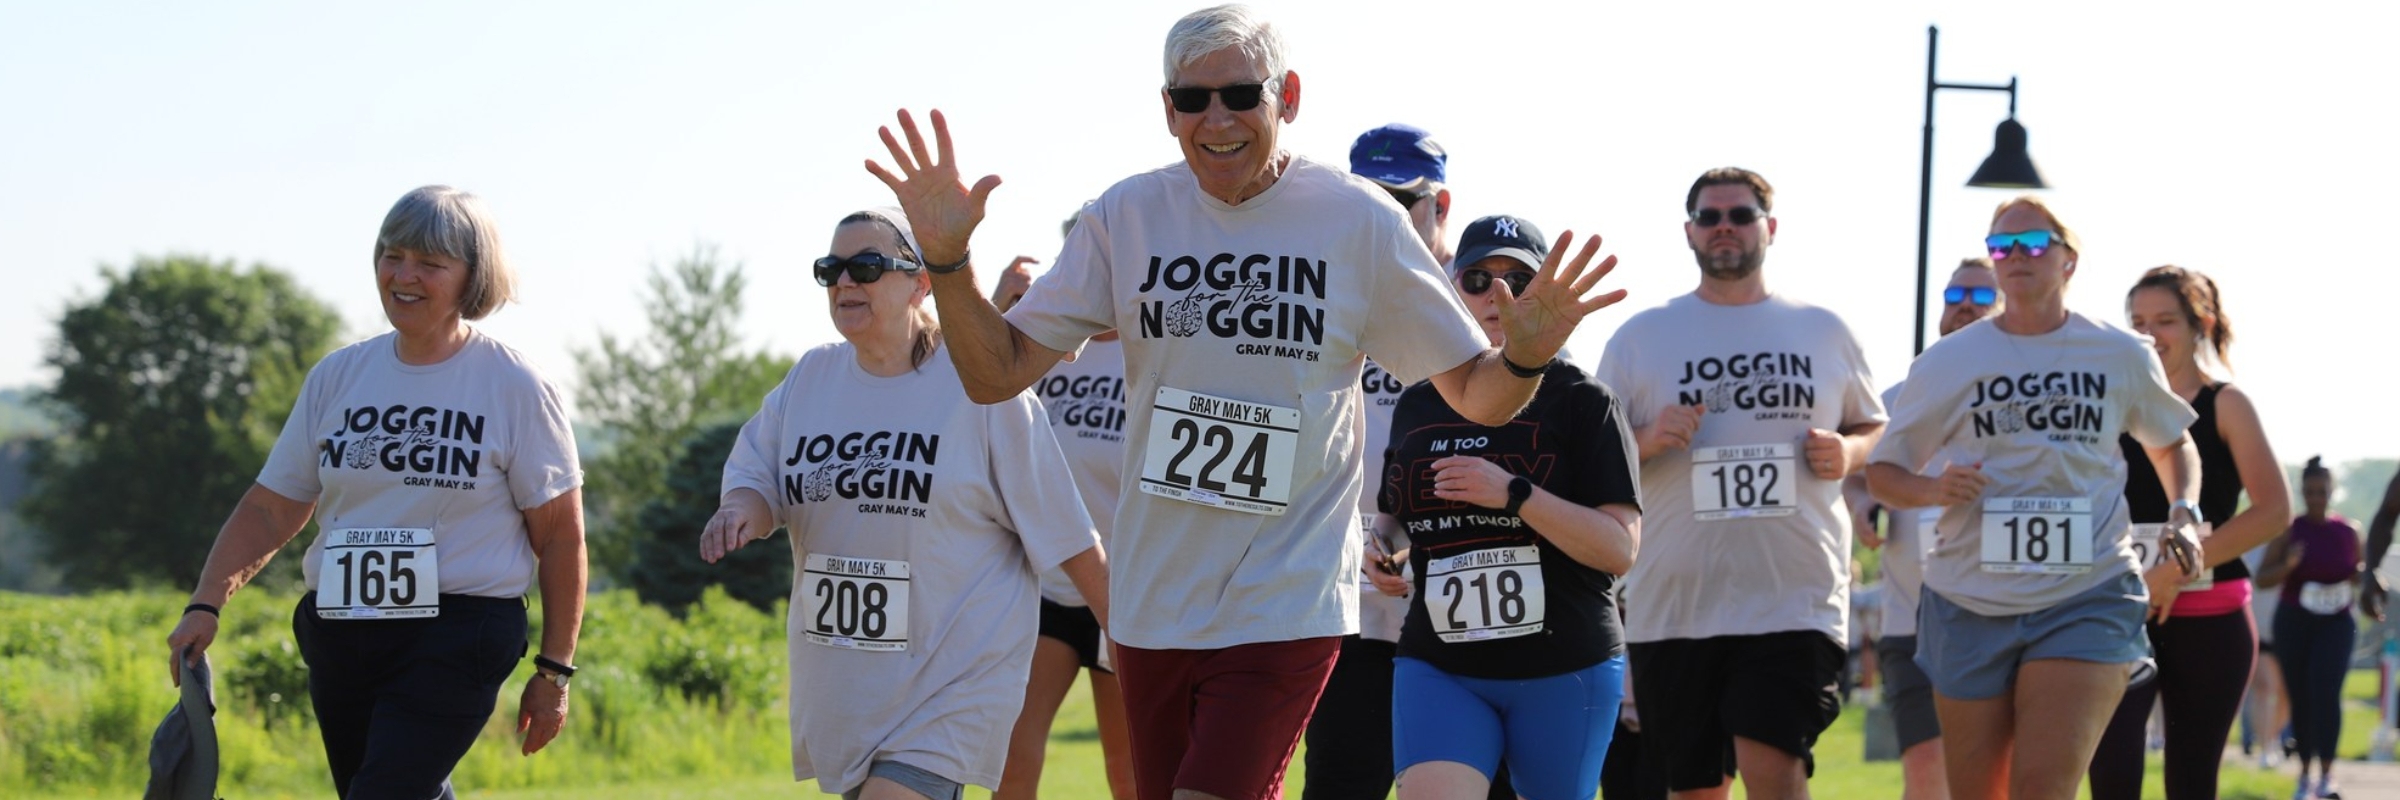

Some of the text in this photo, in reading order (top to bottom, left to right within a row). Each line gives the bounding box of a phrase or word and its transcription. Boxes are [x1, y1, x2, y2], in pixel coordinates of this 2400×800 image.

[1493, 217, 1519, 238] NY
[1139, 253, 1327, 300] JOGGIN
[1181, 282, 1227, 312] for
[1236, 343, 1320, 362] GRAY MAY 5K
[1679, 352, 1812, 385] JOGGIN
[1970, 372, 2106, 408] JOGGIN
[333, 404, 485, 445] JOGGIN
[1189, 395, 1272, 424] GRAY MAY 5K
[785, 431, 940, 467] JOGGIN
[1165, 418, 1269, 498] 224
[1430, 436, 1489, 452] IM TOO
[404, 476, 476, 490] GRAY MAY 5K
[1711, 462, 1779, 508] 182
[886, 505, 909, 516] MAY
[911, 508, 927, 518] 5K
[1407, 514, 1522, 534] FOR MY TUMOR
[346, 530, 414, 544] GRAY MAY 5K
[2003, 516, 2072, 563] 181
[827, 558, 887, 576] GRAY MAY 5K
[1452, 549, 1517, 569] GRAY MAY 5K
[337, 550, 416, 606] 165
[816, 578, 888, 638] 208
[1442, 569, 1526, 629] 218
